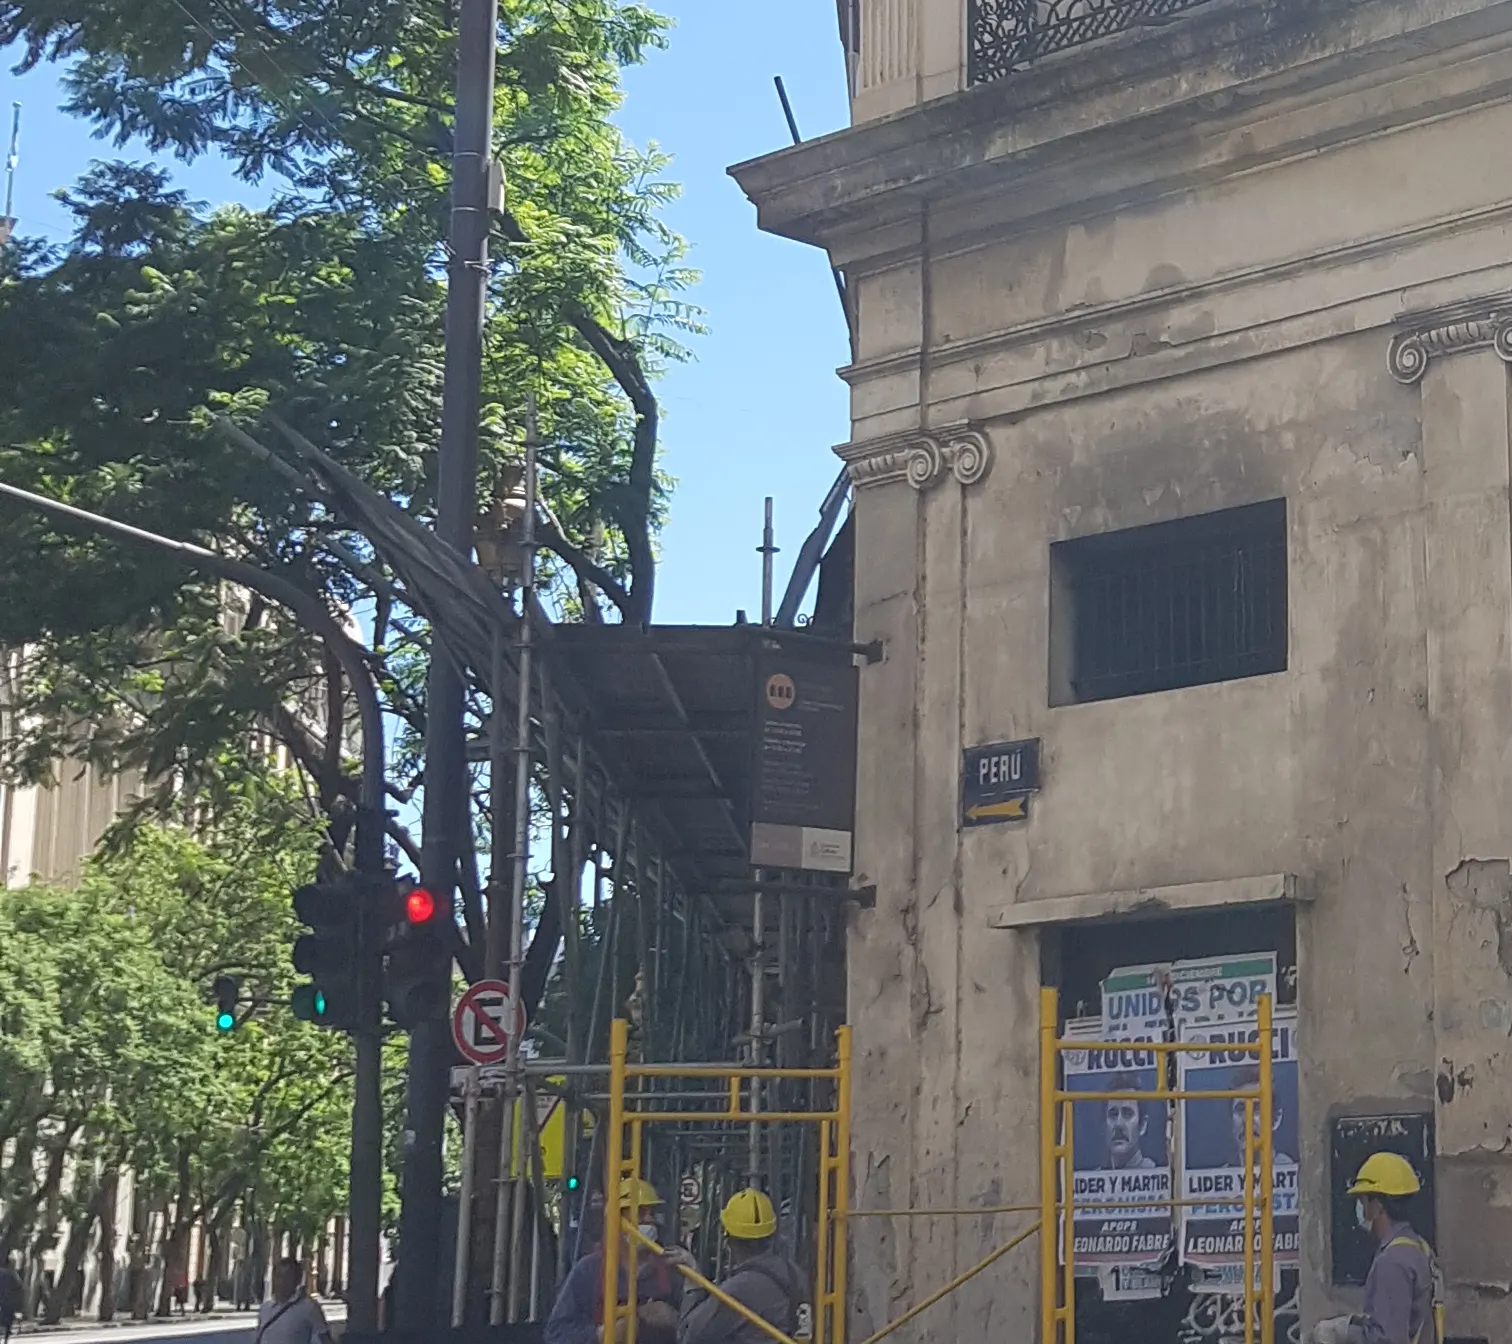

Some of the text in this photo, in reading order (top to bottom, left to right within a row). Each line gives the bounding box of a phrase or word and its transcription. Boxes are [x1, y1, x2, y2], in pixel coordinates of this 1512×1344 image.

[979, 748, 1021, 785] PERÚ
[1073, 1174, 1169, 1194] IDER Y MARTIR
[1188, 1174, 1234, 1194] LIDER
[1252, 1171, 1299, 1190] MRT
[1073, 1195, 1168, 1215] ERONISTA
[1073, 1234, 1170, 1253] EONARDO FABRE
[1187, 1232, 1299, 1254] LEONARO ABR
